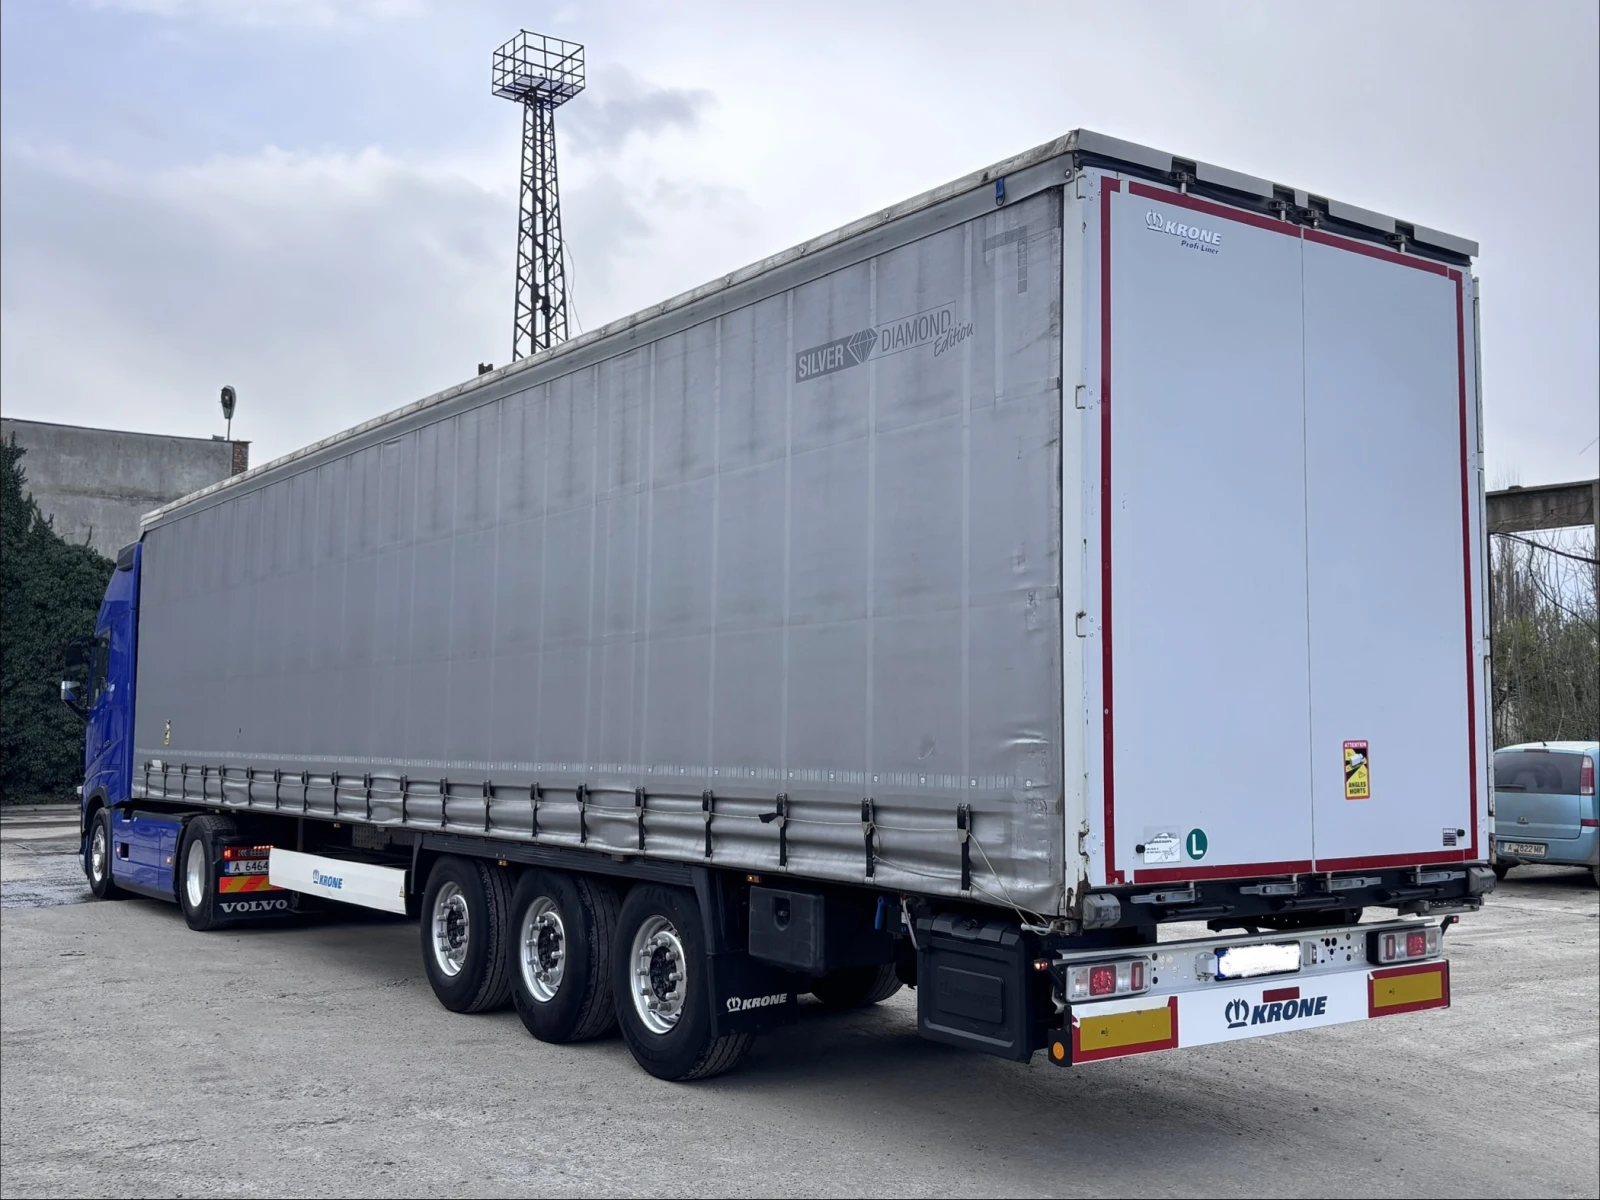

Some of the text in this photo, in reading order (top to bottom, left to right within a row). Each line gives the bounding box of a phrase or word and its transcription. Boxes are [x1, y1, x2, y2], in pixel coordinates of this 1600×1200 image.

[1164, 220, 1222, 247] KRONE
[1180, 239, 1219, 255] Profi Liner
[798, 309, 951, 379] SILVER DIAMOND
[933, 321, 974, 358] Edition
[1349, 787, 1366, 795] MORTS
[1191, 833, 1204, 856] L
[233, 860, 269, 872] A 6464
[319, 873, 344, 890] KRONE
[219, 899, 288, 913] VOLVO
[742, 992, 788, 1011] KRONE
[1251, 995, 1328, 1025] KRONE
